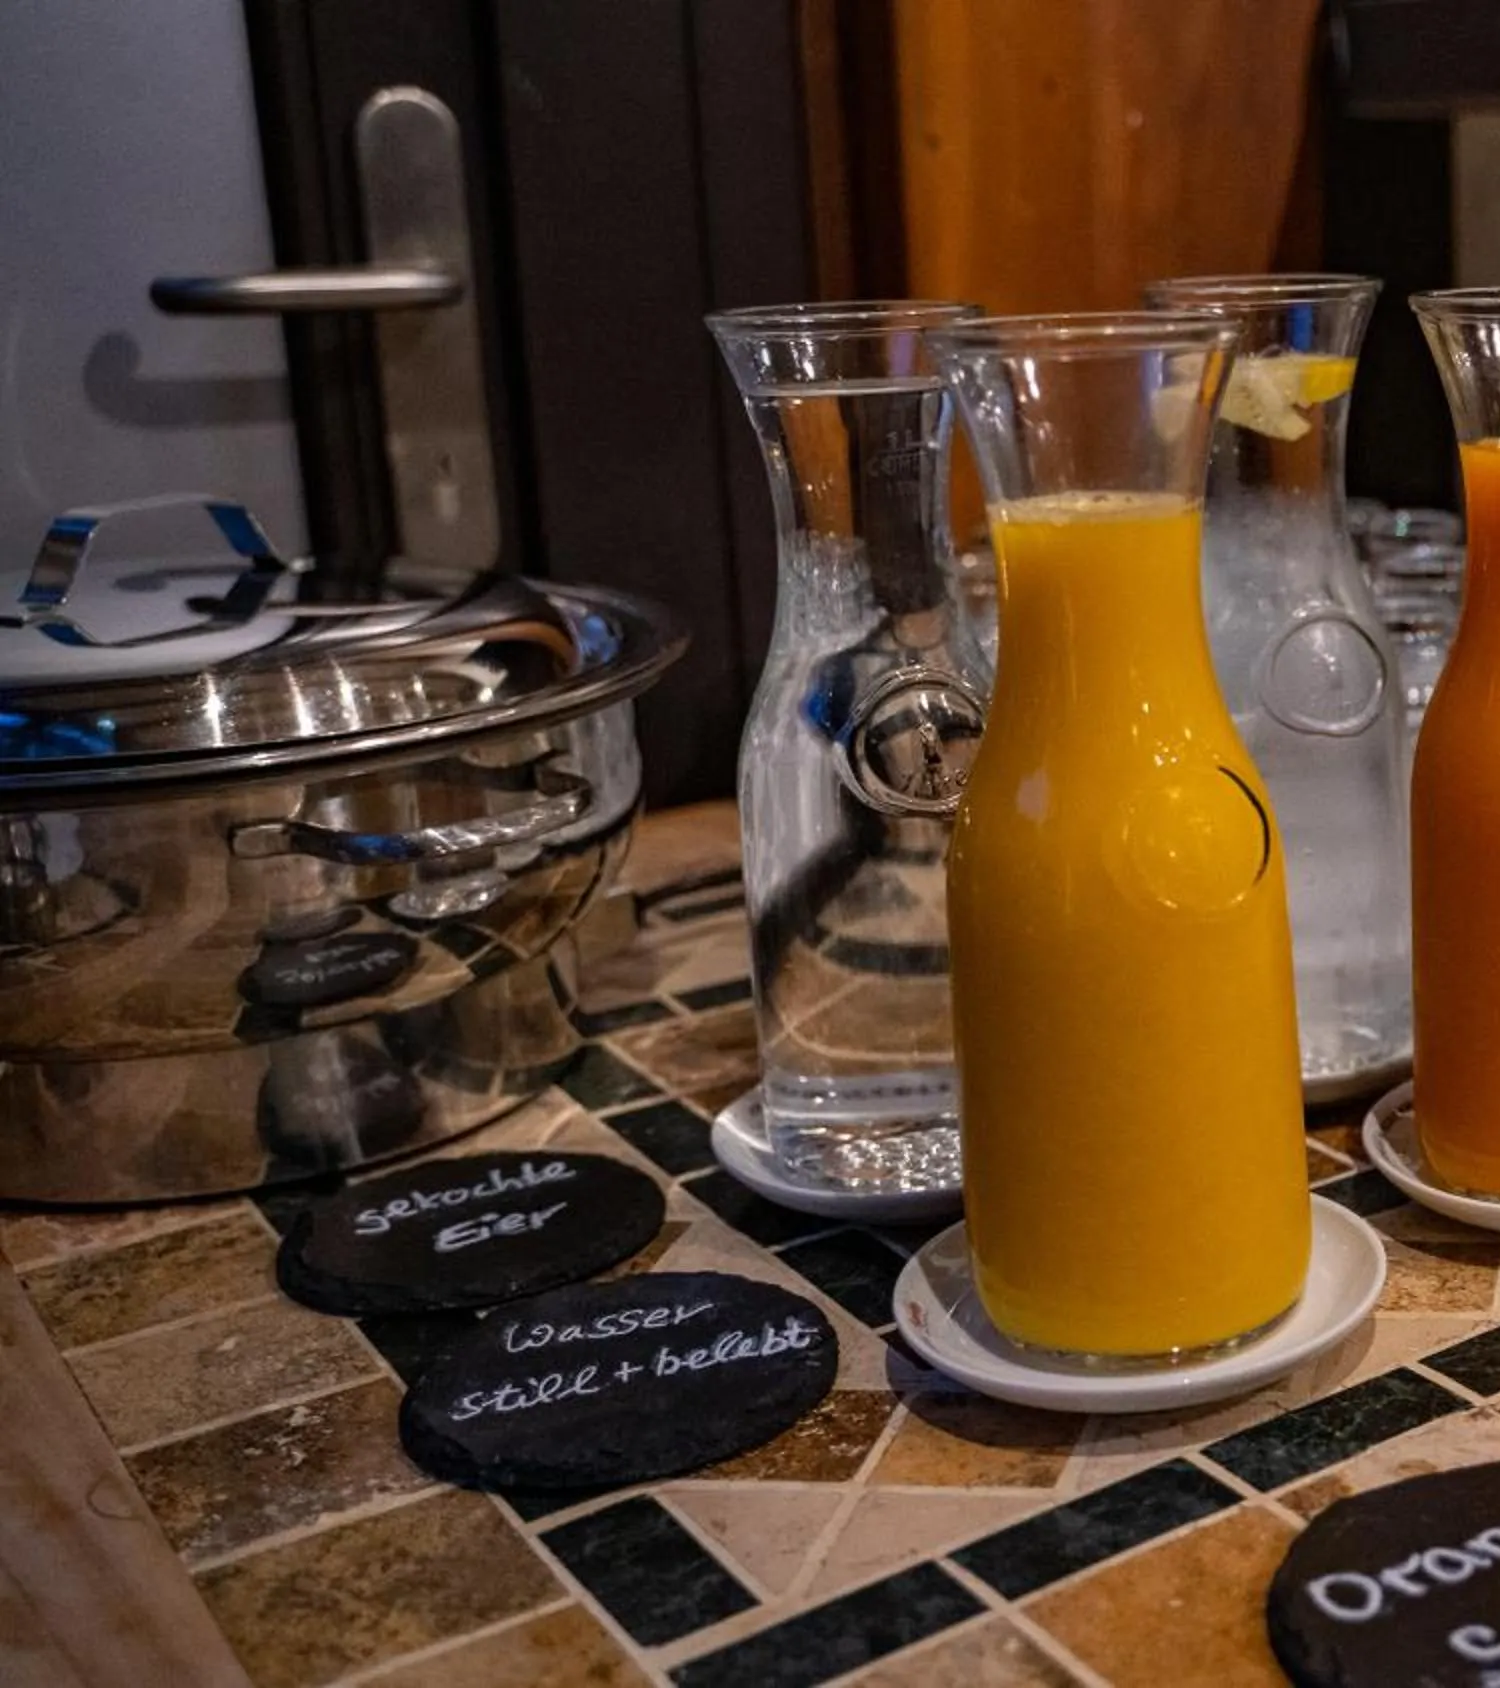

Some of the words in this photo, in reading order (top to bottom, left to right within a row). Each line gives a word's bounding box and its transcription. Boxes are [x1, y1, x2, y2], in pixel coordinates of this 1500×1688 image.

[433, 1201, 569, 1253] Eier
[447, 1363, 600, 1421] still
[614, 1359, 645, 1384] +
[654, 1314, 820, 1378] belebt
